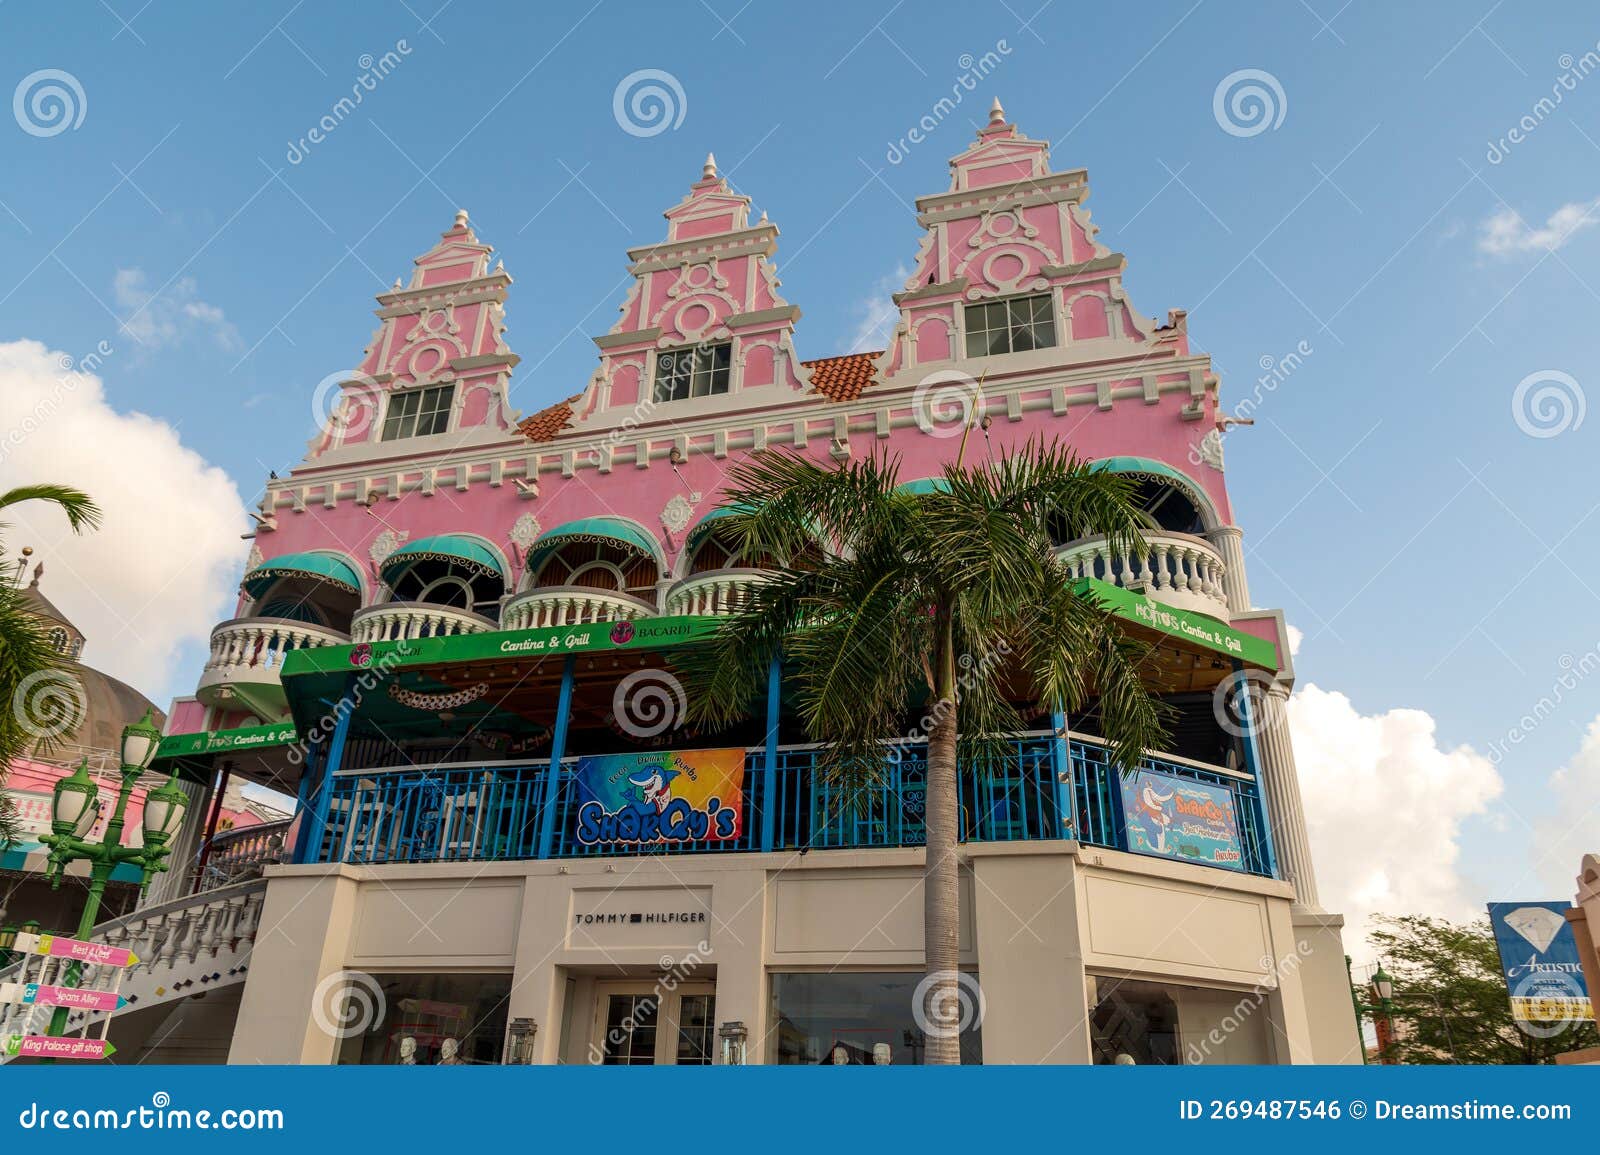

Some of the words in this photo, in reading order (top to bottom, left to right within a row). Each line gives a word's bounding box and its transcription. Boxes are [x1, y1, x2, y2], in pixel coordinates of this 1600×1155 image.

[639, 625, 691, 638] BACARDI
[1181, 620, 1213, 643] Cantina
[1214, 632, 1223, 645] &
[1225, 636, 1242, 652] Grill
[500, 640, 545, 652] Cantina
[549, 636, 560, 648] &
[565, 633, 590, 649] Grill
[375, 648, 422, 659] BAARDI
[233, 734, 265, 745] Cantina
[267, 731, 275, 741] &
[674, 757, 698, 782] Rumba
[575, 914, 627, 924] TOMMY
[646, 912, 705, 923] HILFIGER
[23, 1040, 41, 1054] King
[42, 1041, 71, 1052] Palace
[71, 1042, 85, 1055] gift
[84, 1043, 103, 1055] shop
